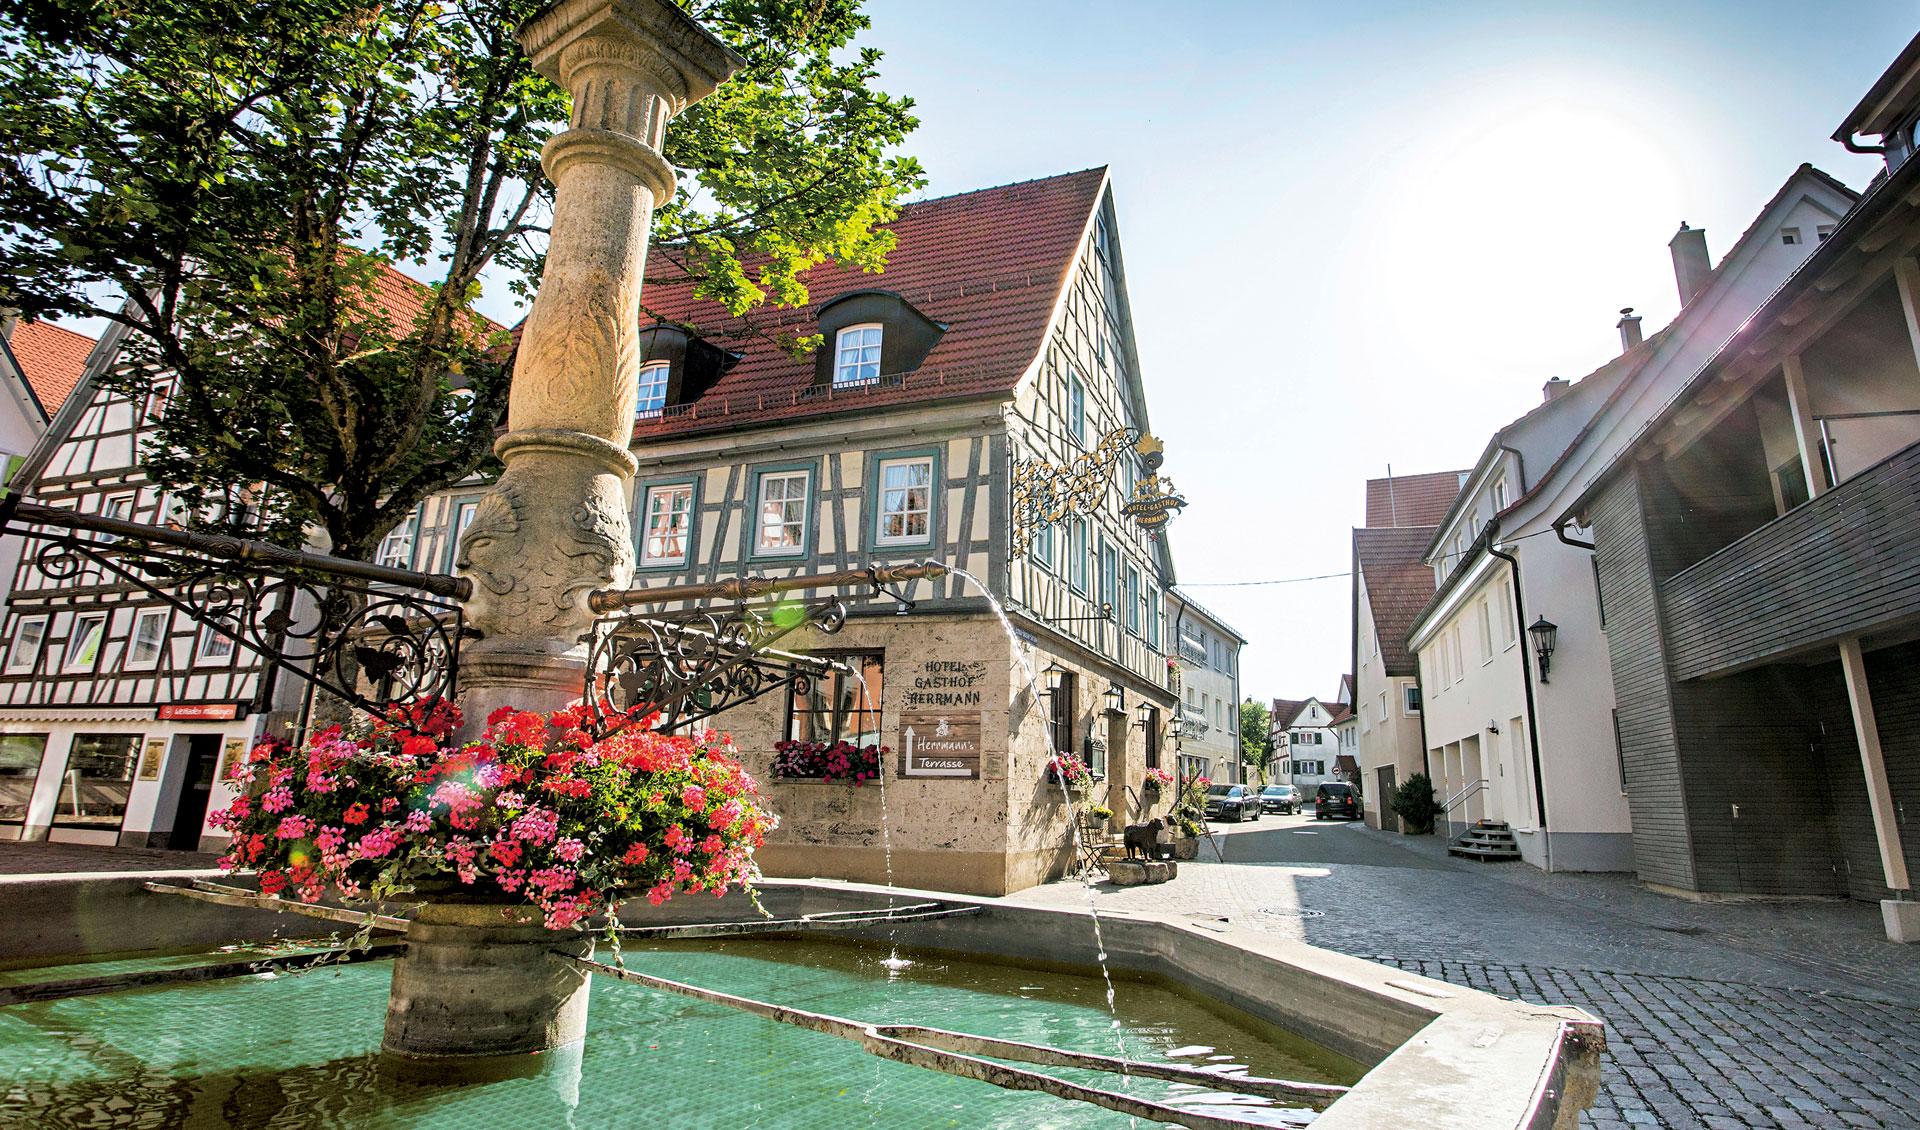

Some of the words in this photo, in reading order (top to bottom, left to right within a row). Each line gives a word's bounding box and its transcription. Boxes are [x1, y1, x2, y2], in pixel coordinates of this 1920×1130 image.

[925, 661, 964, 672] HOTEL
[914, 677, 975, 689] GASTHOF
[909, 691, 980, 706] HERRMANN
[917, 736, 974, 751] Herrmann's
[920, 757, 964, 768] Terrasse
